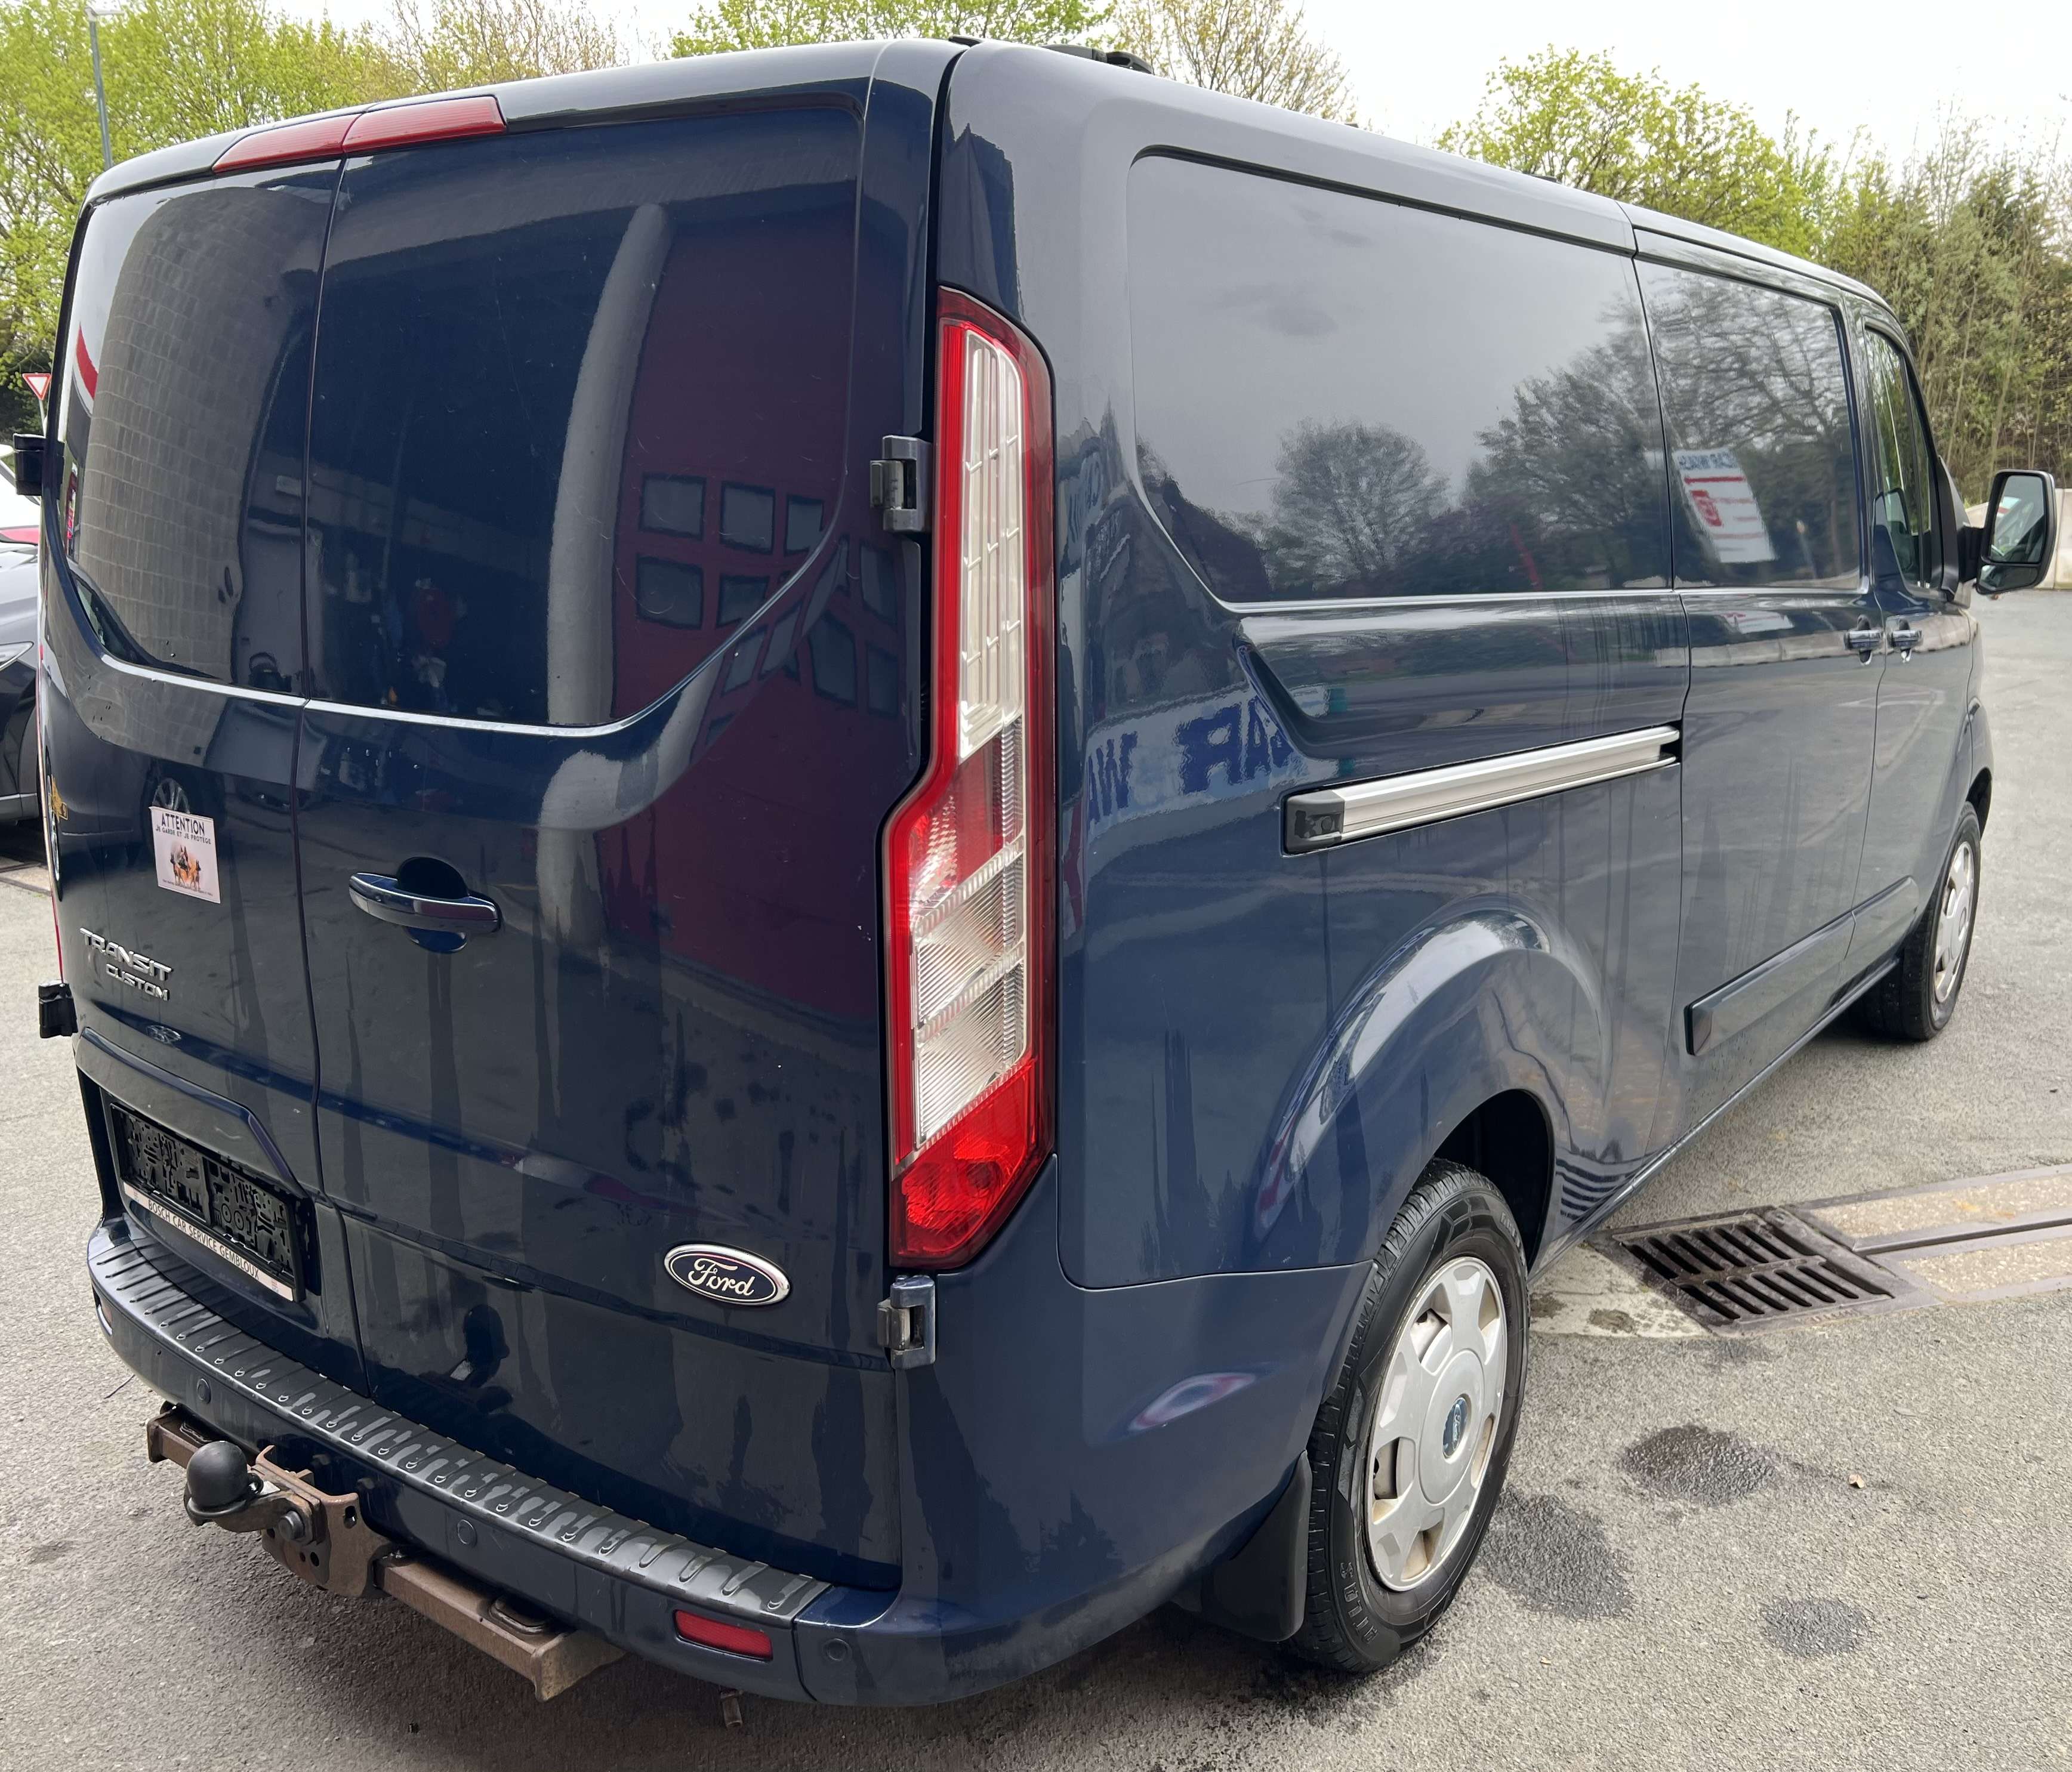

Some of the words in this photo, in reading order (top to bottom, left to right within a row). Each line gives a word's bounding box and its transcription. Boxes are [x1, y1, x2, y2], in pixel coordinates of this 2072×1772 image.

[162, 813, 205, 835] ATTENTION
[79, 928, 172, 981] TRANSIT
[106, 964, 169, 1001] CUSTOM
[148, 1199, 171, 1224] BOSCH
[173, 1215, 187, 1233] CAR
[189, 1225, 217, 1251] SERVICE
[220, 1245, 259, 1279] GEMBLOUX
[688, 1258, 756, 1296] Ford
